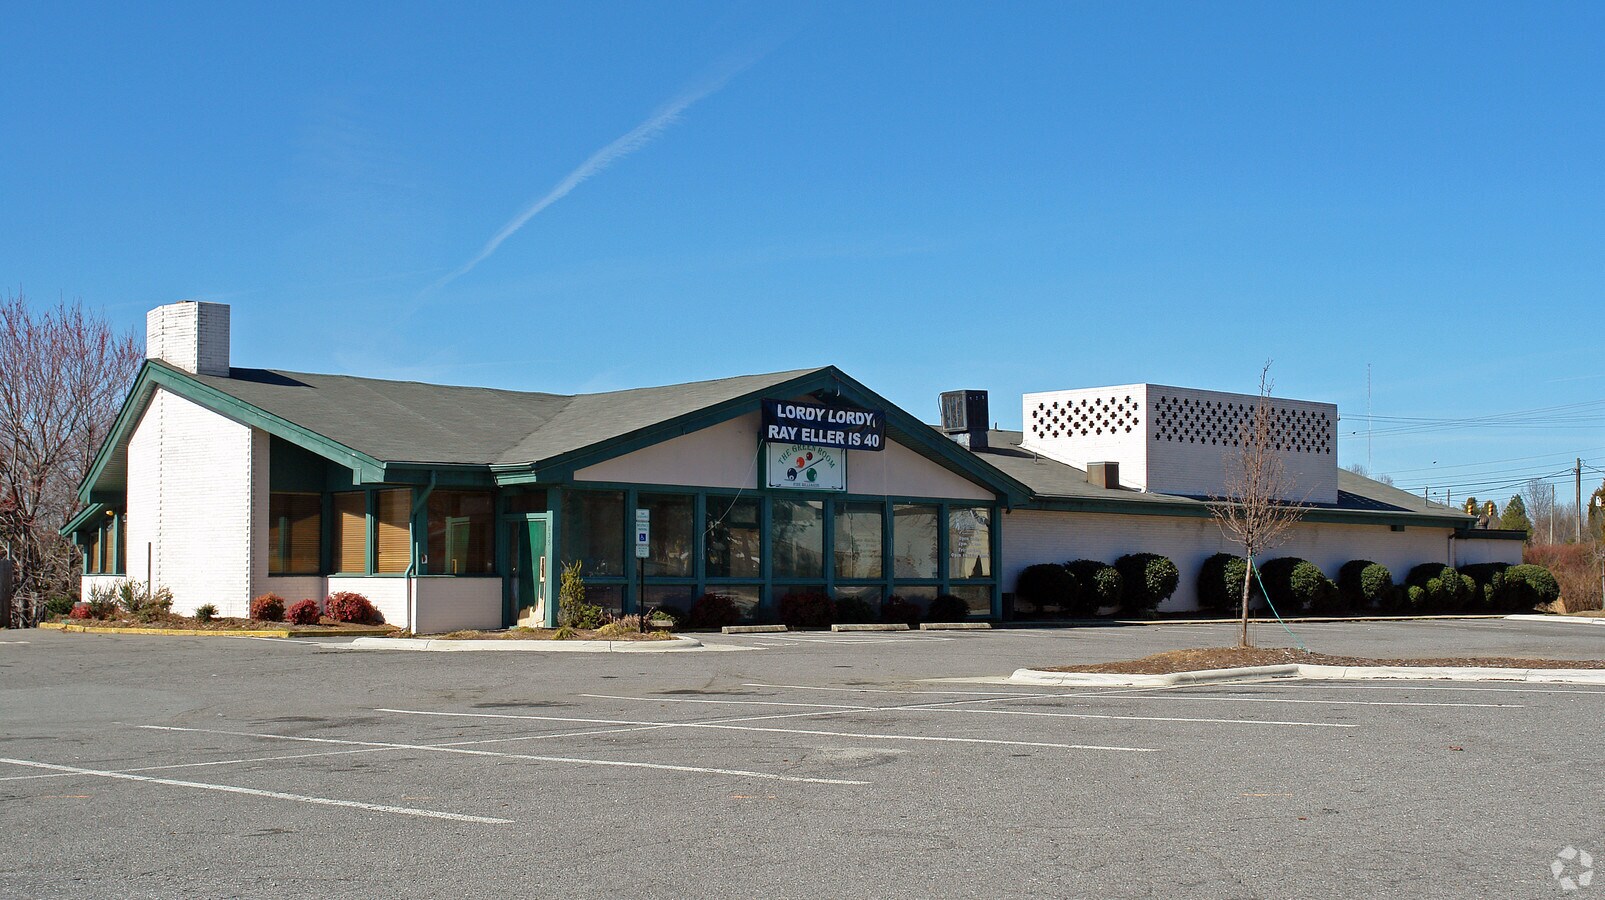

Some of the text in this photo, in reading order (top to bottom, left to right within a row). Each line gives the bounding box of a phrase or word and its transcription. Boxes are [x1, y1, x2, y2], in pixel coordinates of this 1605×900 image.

[777, 404, 826, 421] LORDY
[768, 425, 880, 448] RAY ELLER IS 40
[778, 444, 836, 469] THE GREEN ROOM
